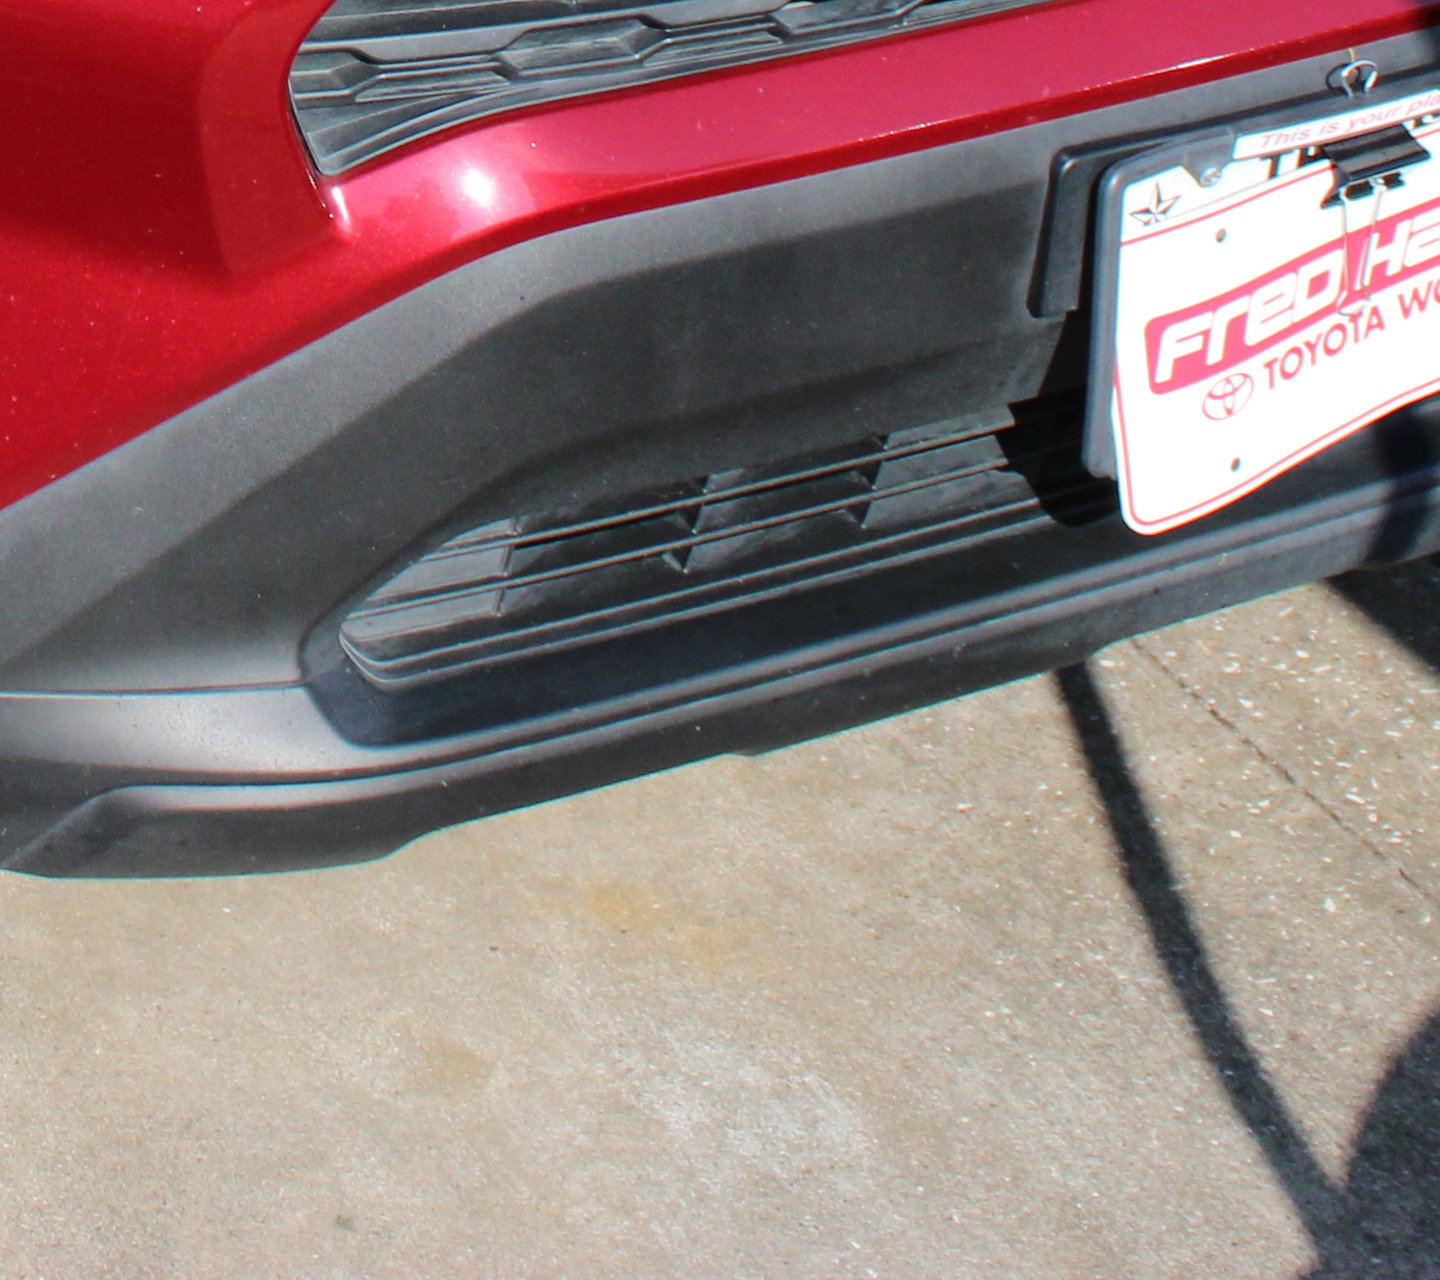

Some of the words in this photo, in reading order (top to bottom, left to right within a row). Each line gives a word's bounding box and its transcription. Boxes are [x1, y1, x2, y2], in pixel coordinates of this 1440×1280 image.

[1261, 126, 1310, 148] This
[1320, 120, 1339, 135] is
[1344, 105, 1403, 133] your
[1263, 310, 1386, 390] TOYOTA
